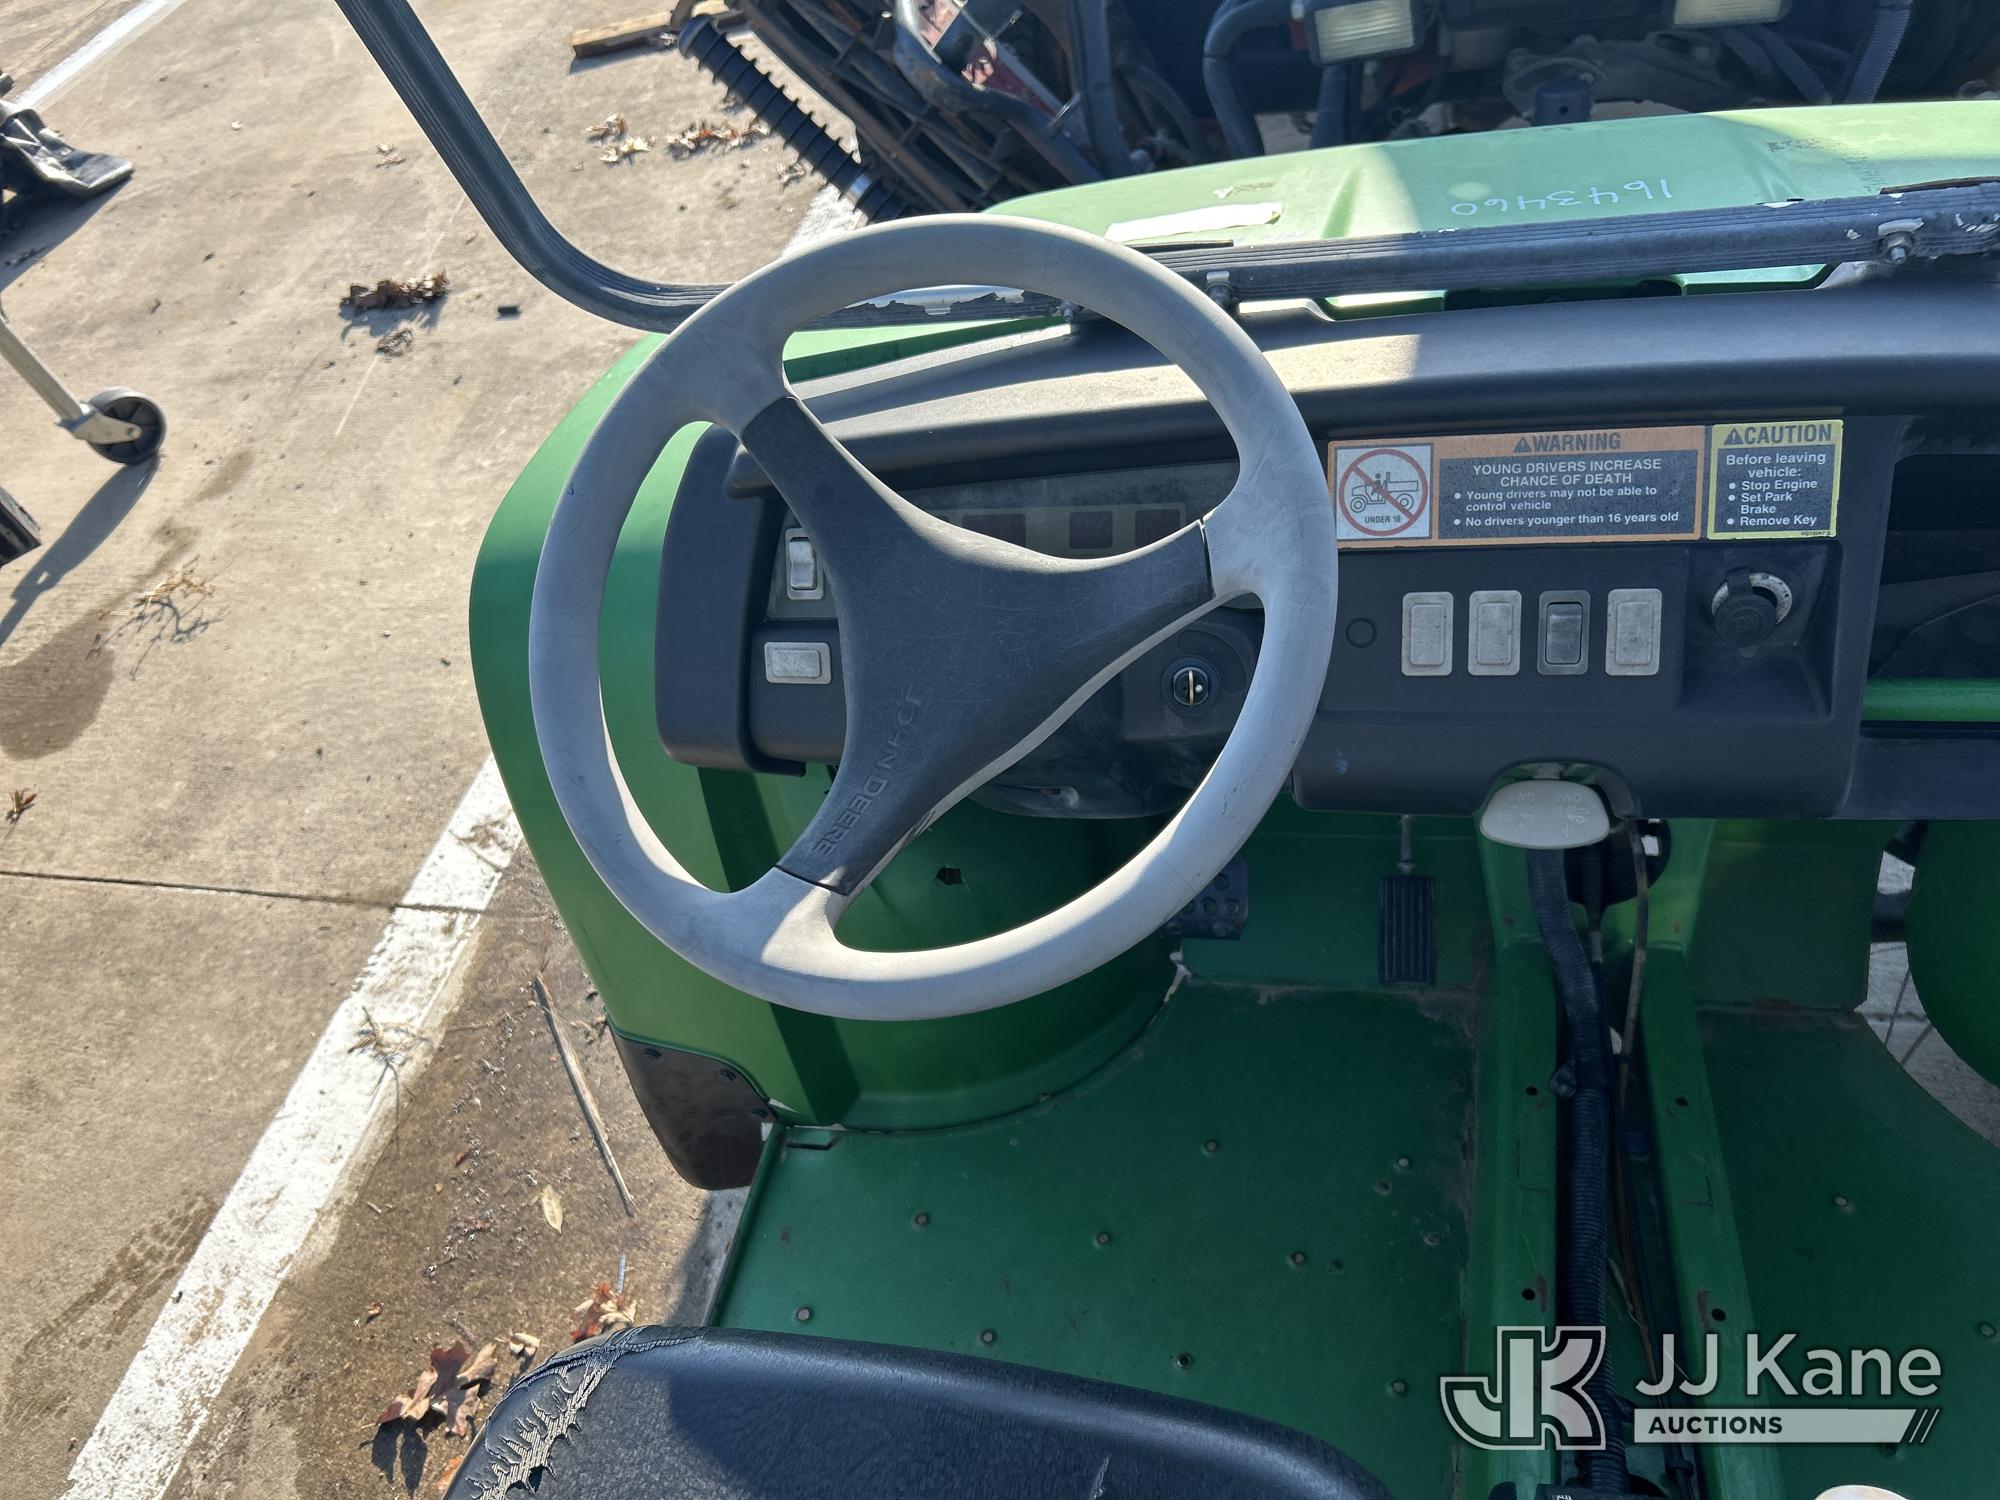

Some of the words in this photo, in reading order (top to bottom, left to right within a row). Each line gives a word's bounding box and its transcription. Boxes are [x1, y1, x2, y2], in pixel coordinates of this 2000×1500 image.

[1744, 424, 1832, 444] CAUTION
[1532, 432, 1621, 452] WARNING
[1726, 454, 1771, 465] Before
[1776, 452, 1826, 465] leaving
[1473, 463, 1521, 475] YOUNG
[1526, 461, 1586, 473] DRIVERS
[1590, 459, 1662, 471] INCREASE
[1748, 467, 1801, 478] vehicle:
[1500, 475, 1558, 487] CHANCE
[1562, 474, 1581, 485] OF
[1585, 473, 1632, 485] DEATH
[1742, 481, 1770, 492] Stop
[1774, 479, 1818, 491] Engine
[1467, 491, 1503, 501] Young
[1506, 489, 1547, 499] drivers
[1550, 490, 1574, 499] may
[1577, 488, 1596, 497] not
[1600, 487, 1614, 496] be
[1617, 486, 1642, 496] able
[1645, 486, 1657, 495] to
[1741, 493, 1761, 502] Set
[1765, 492, 1793, 501] Park
[1465, 502, 1506, 512] control
[1510, 501, 1552, 510] vehicle
[1740, 504, 1776, 514] Brake
[1364, 515, 1391, 524] UNDER
[1465, 517, 1481, 527] No
[1484, 516, 1524, 526] drivers
[1527, 515, 1575, 527] younger
[1579, 514, 1604, 524] than
[1608, 513, 1621, 523] 16
[1624, 514, 1657, 525] years
[1660, 512, 1679, 522] old
[1740, 516, 1790, 526] Remove
[1793, 514, 1817, 526] Key
[876, 684, 922, 770] JOHN
[812, 774, 889, 855] DEERE
